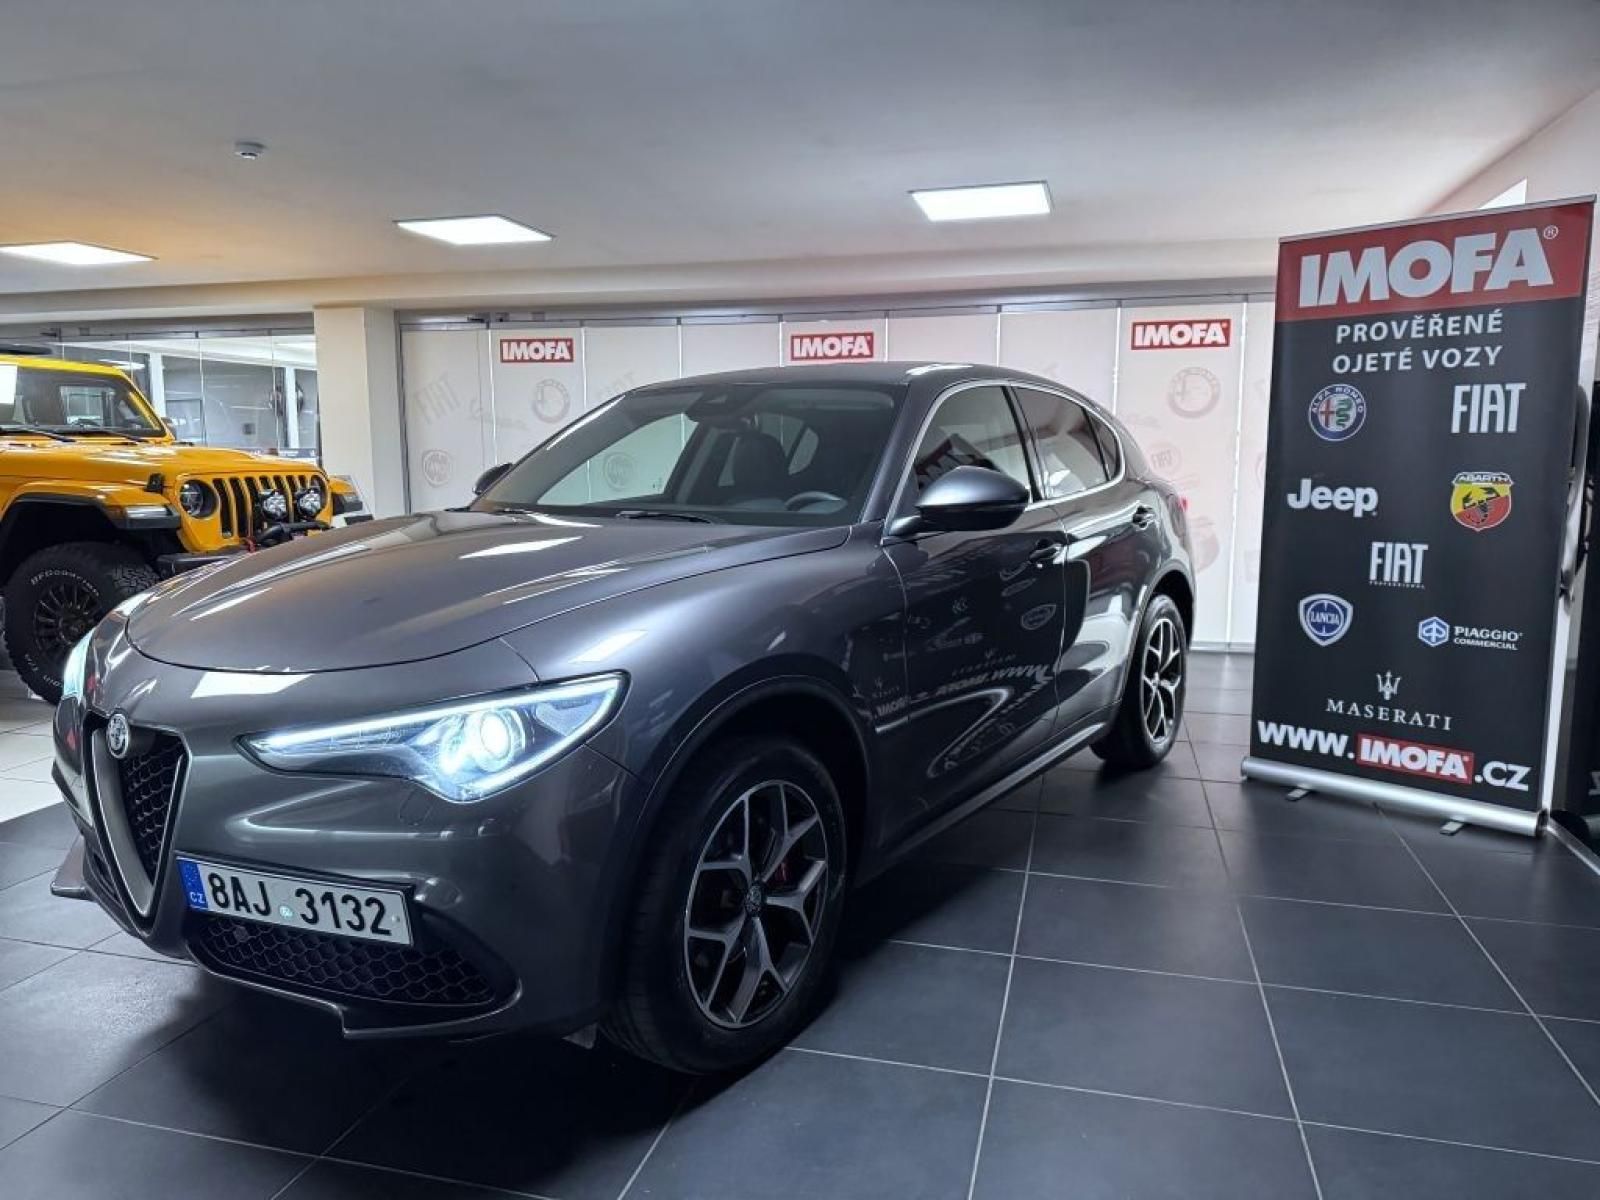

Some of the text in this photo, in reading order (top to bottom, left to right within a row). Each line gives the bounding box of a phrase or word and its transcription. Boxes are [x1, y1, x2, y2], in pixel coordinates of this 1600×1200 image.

[1299, 228, 1554, 308] IMOFA
[1135, 322, 1226, 346] IMOFA
[1335, 309, 1504, 344] PROVĚŘENÉ
[502, 341, 571, 360] IMOFA
[793, 335, 871, 357] IMOFA
[1332, 345, 1503, 375] OJETÉ VOZY
[1450, 382, 1527, 434] FIAT
[1286, 477, 1379, 518] Jeep
[1369, 541, 1429, 584] FIAT
[1453, 625, 1519, 641] PIAGGIO
[1325, 698, 1453, 731] MASERATI
[189, 891, 206, 904] CZ
[207, 872, 393, 937] 8AJ 3132
